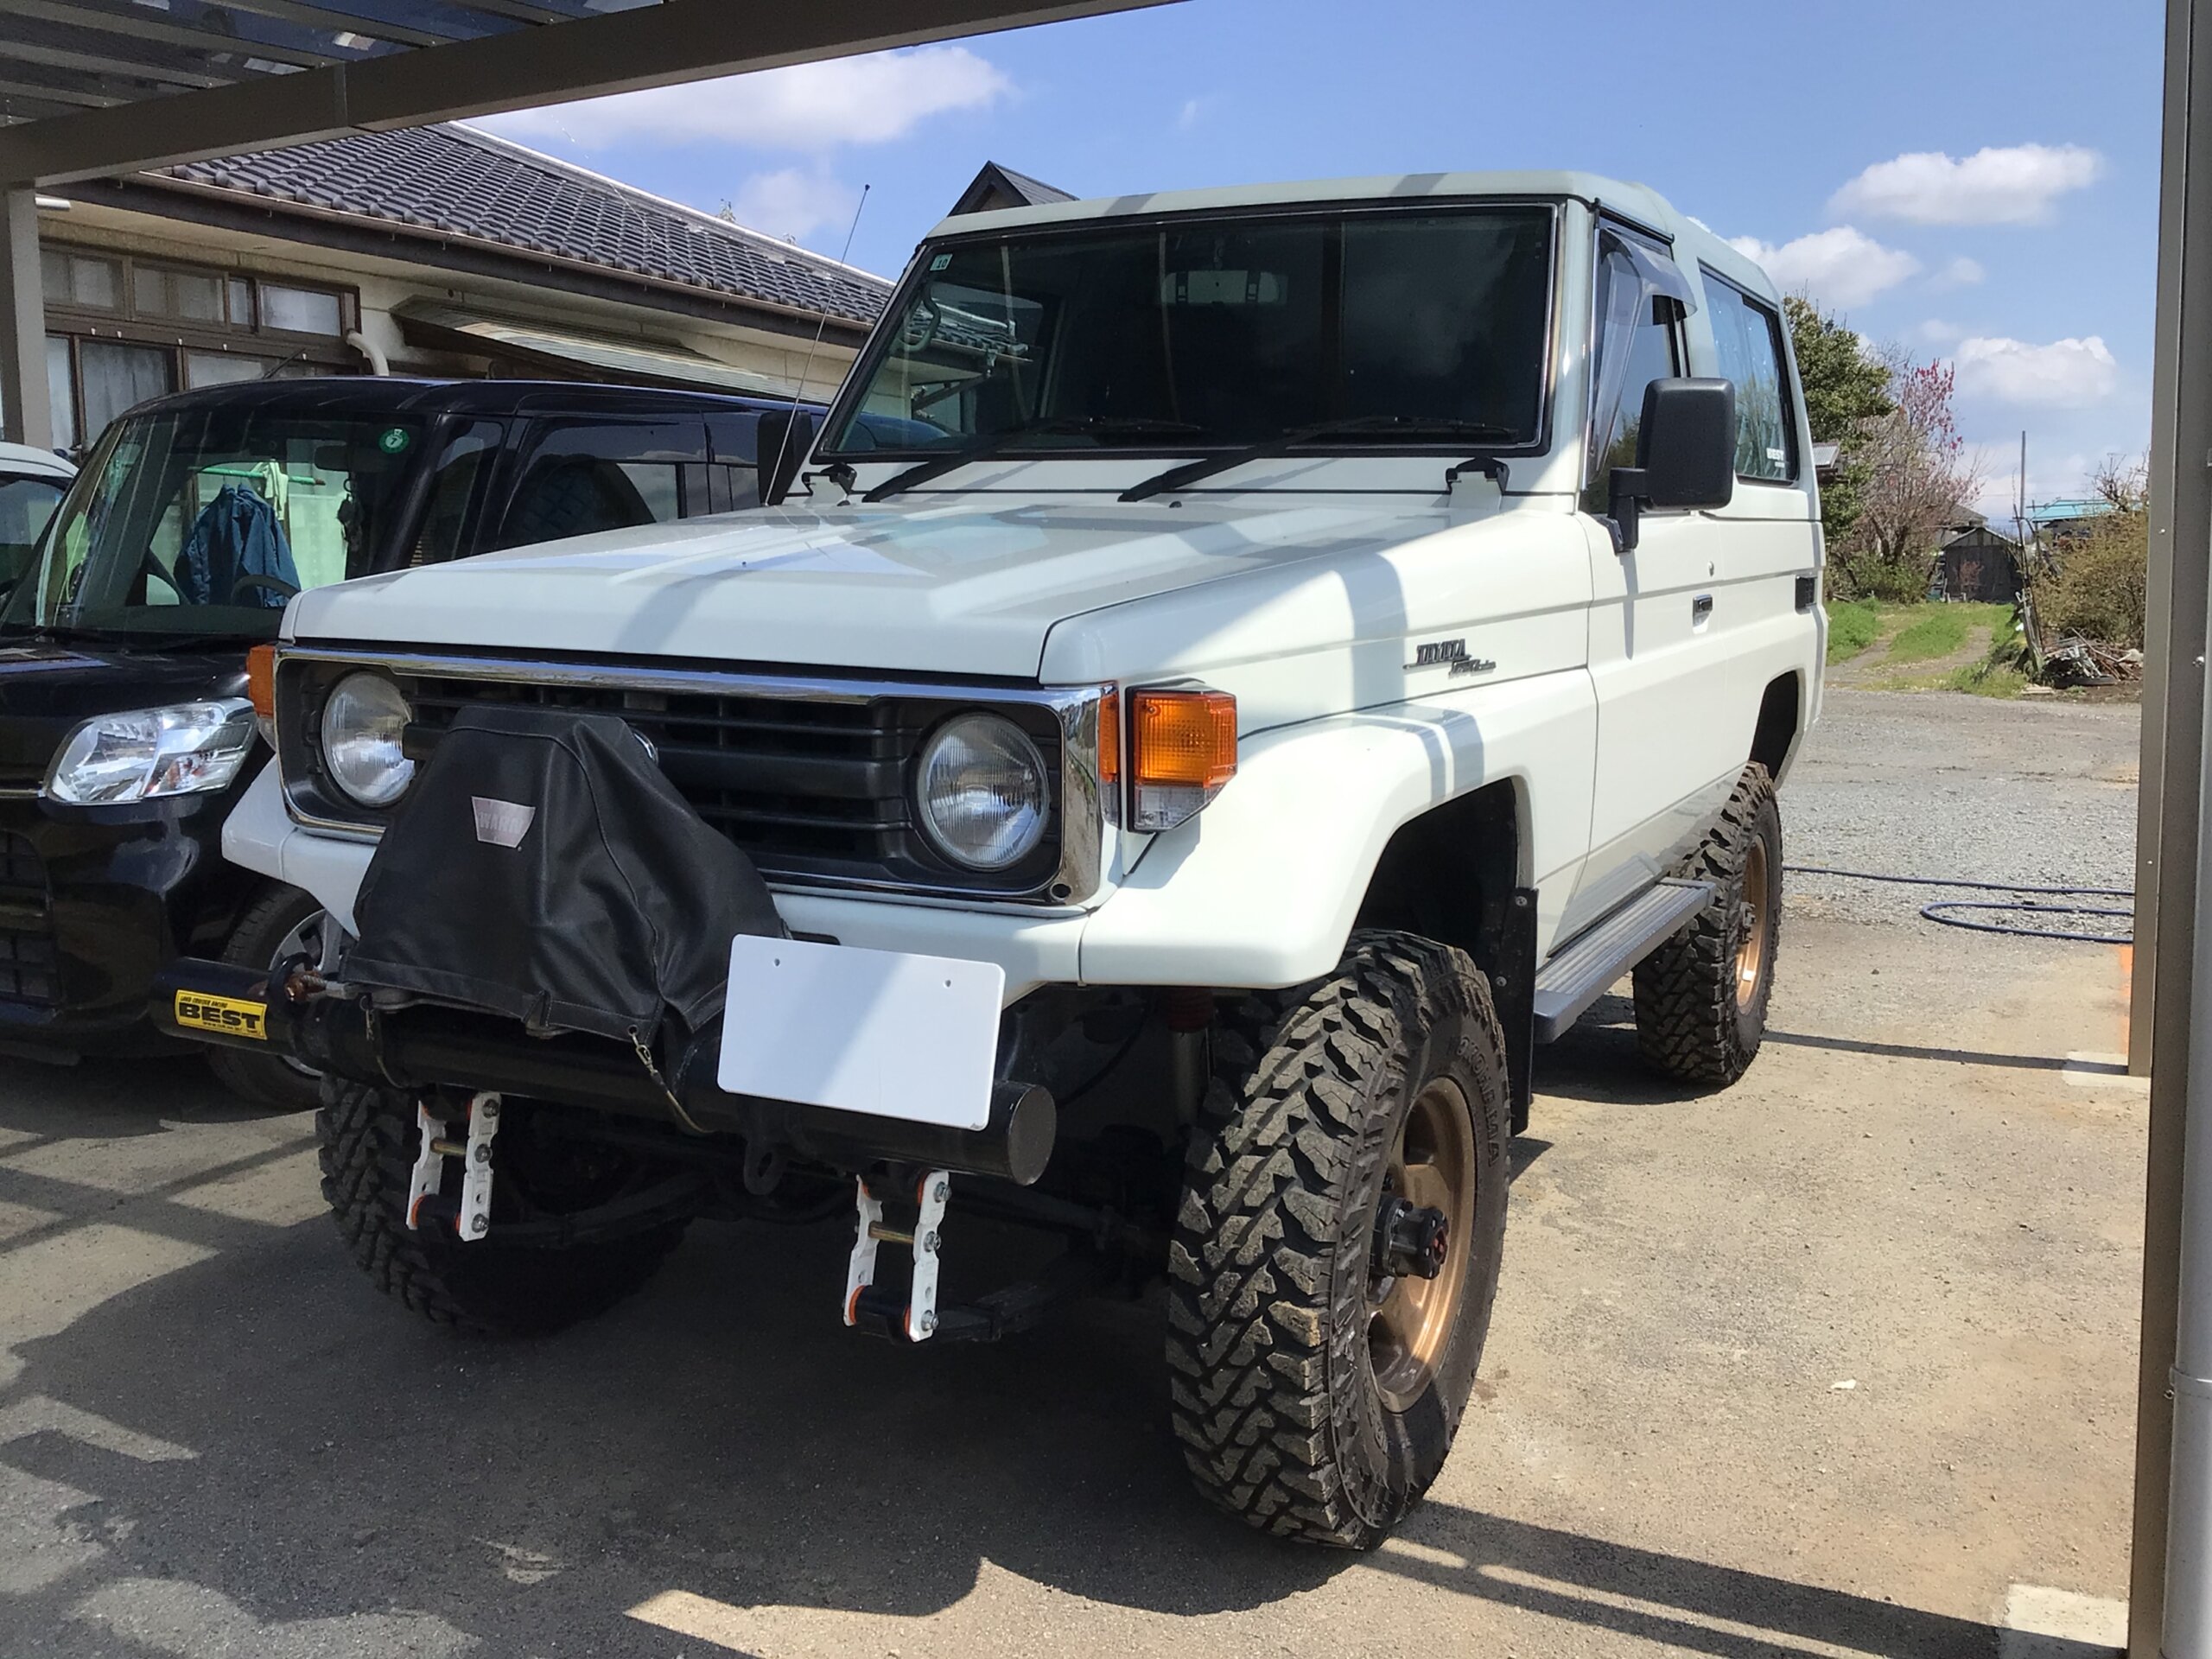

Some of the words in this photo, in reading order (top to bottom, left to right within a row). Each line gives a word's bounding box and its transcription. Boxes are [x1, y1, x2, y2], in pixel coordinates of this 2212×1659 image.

[1416, 639, 1465, 664] TOYOTA
[478, 811, 524, 834] WARN
[179, 1002, 260, 1029] BEST
